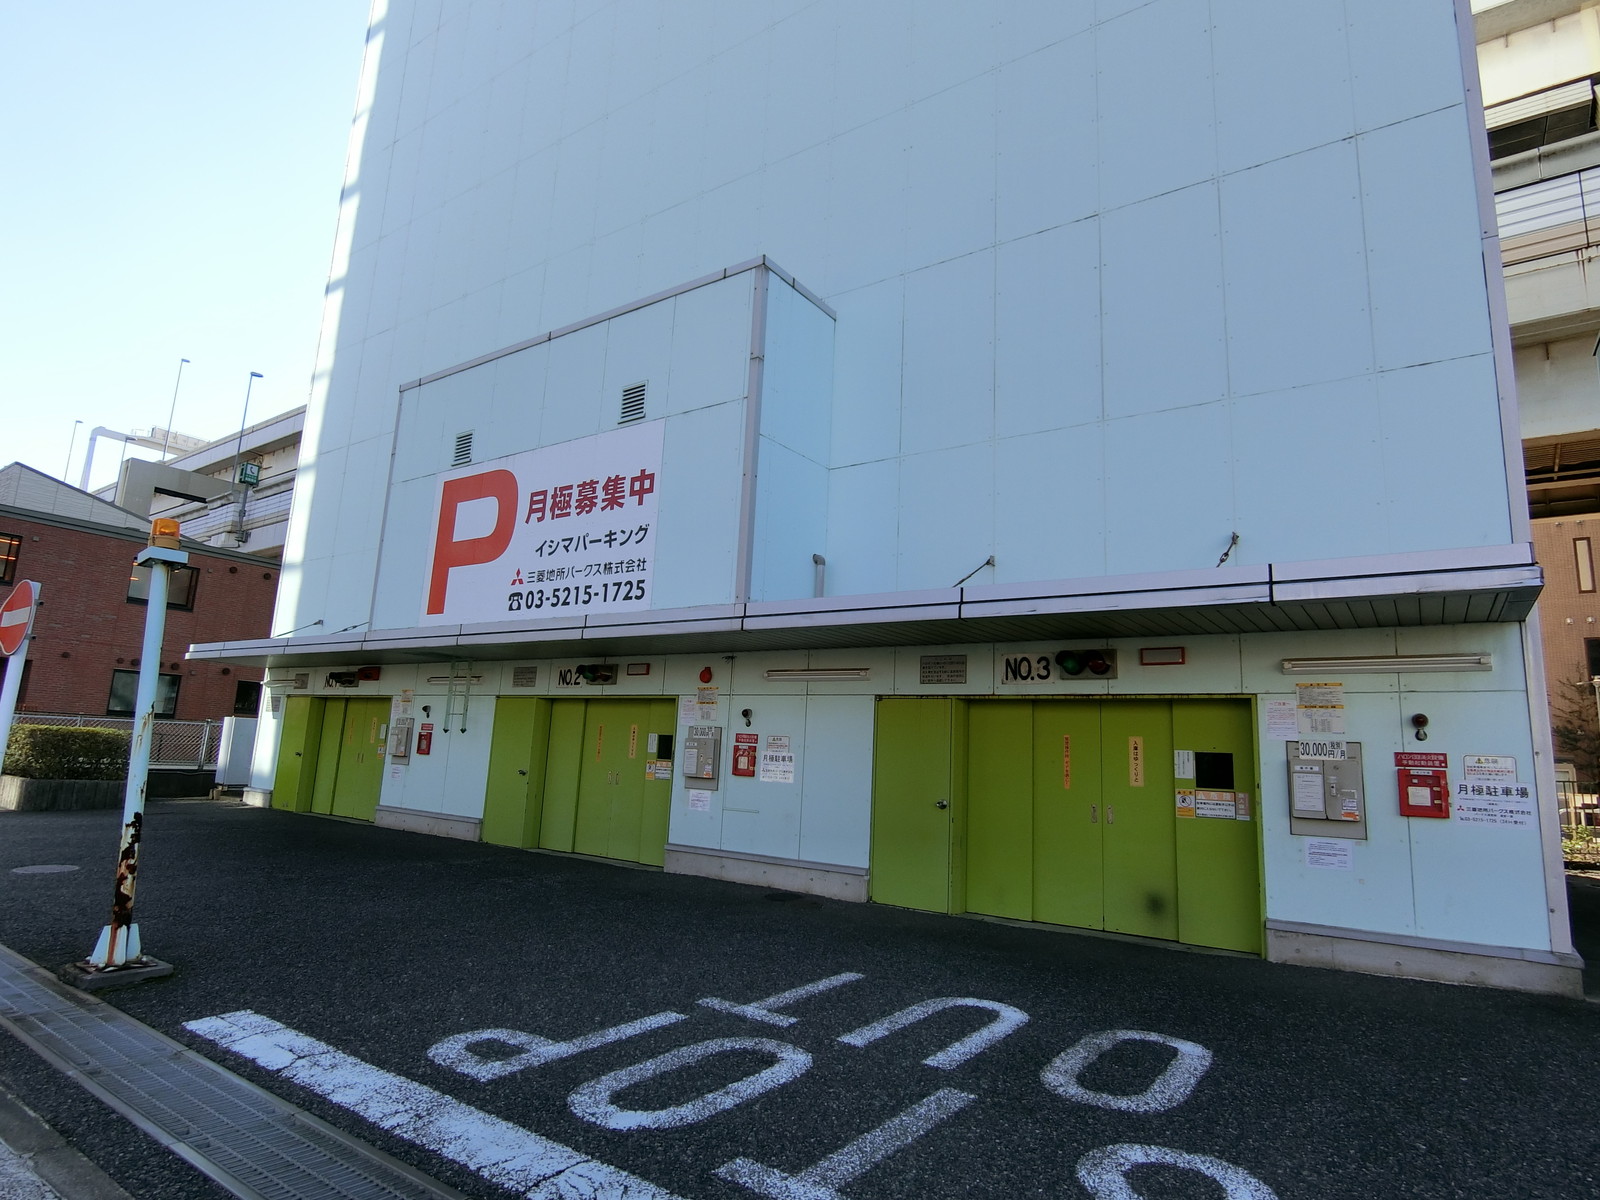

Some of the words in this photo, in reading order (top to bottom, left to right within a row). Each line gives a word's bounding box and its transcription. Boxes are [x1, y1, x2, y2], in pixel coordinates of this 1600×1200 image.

[525, 468, 656, 525] 月極募集中
[426, 469, 519, 614] P
[535, 523, 650, 558] イシマパーキング
[526, 557, 647, 584] 三菱地所パークス株式会社
[526, 579, 646, 610] 03-5215-1725
[558, 668, 581, 686] NO.2
[1005, 655, 1052, 681] NO.3
[1300, 742, 1328, 757] 30,000
[1457, 784, 1530, 799] 月極駐車場
[694, 971, 1214, 1113] OUT
